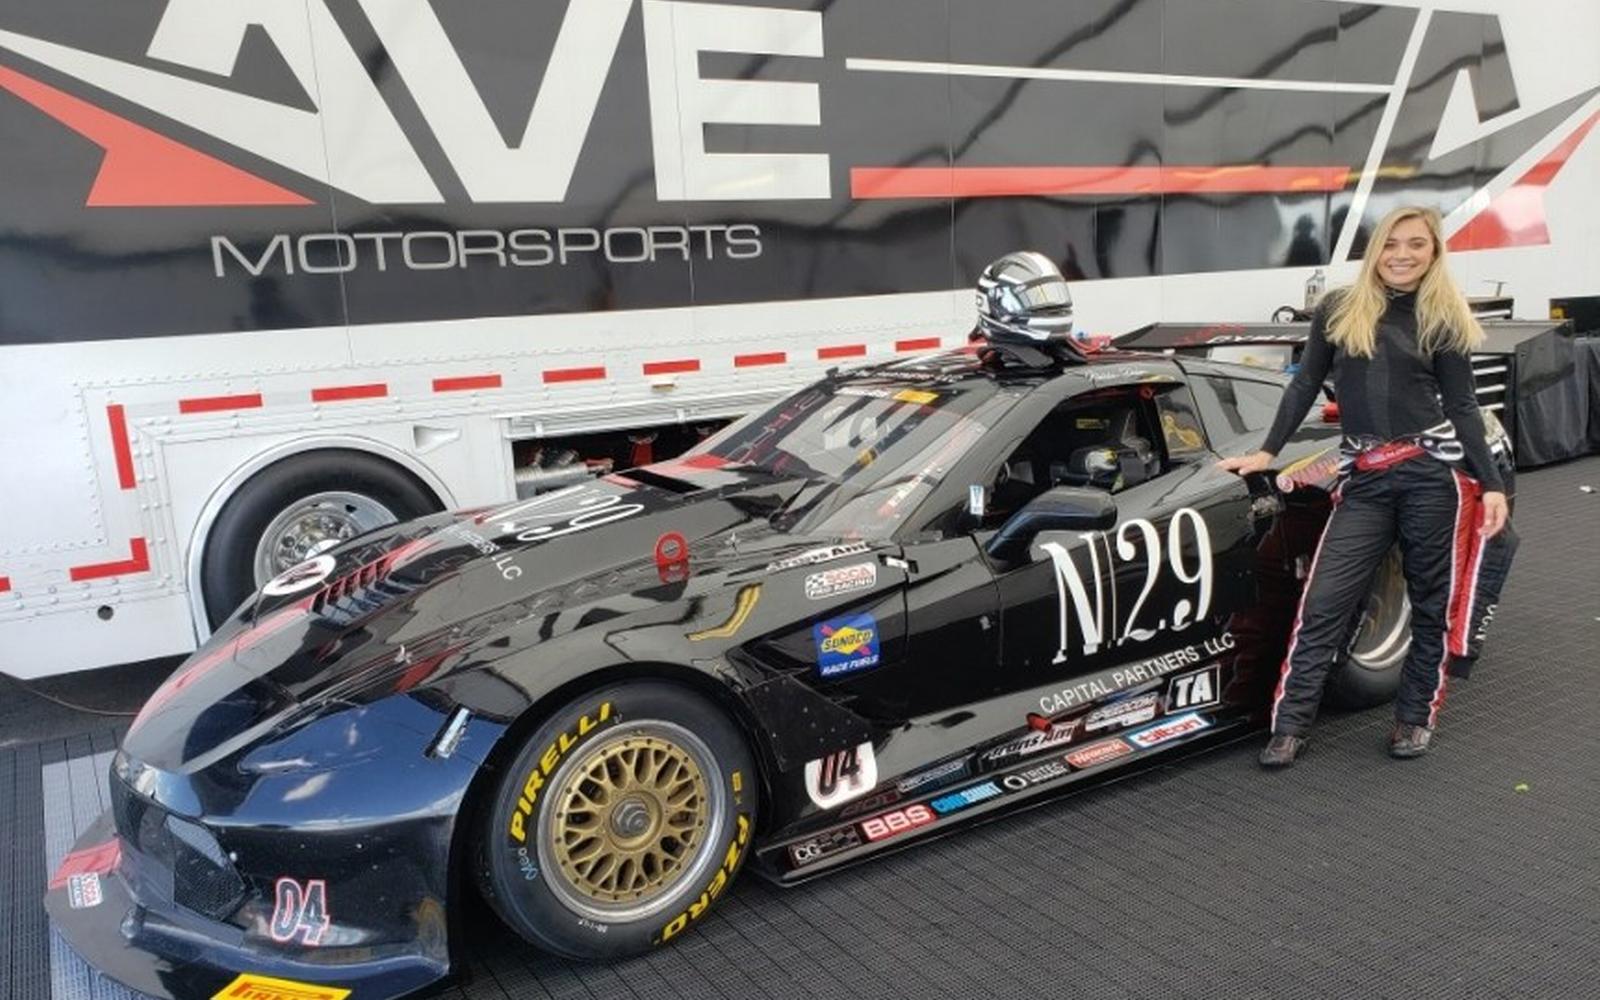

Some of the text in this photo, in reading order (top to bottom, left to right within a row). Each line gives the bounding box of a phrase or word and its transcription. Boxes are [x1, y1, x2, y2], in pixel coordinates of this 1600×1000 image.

[211, 224, 762, 278] MOTORSPORTS
[822, 628, 874, 653] SUNOCO
[821, 653, 880, 677] RACE FUELS
[1039, 683, 1111, 715] CAPITAL
[1112, 645, 1200, 688] PARTNERS
[1204, 631, 1236, 655] LLC
[1176, 671, 1214, 708] TA
[510, 702, 611, 842] PIRELLI
[862, 803, 932, 841] BBS
